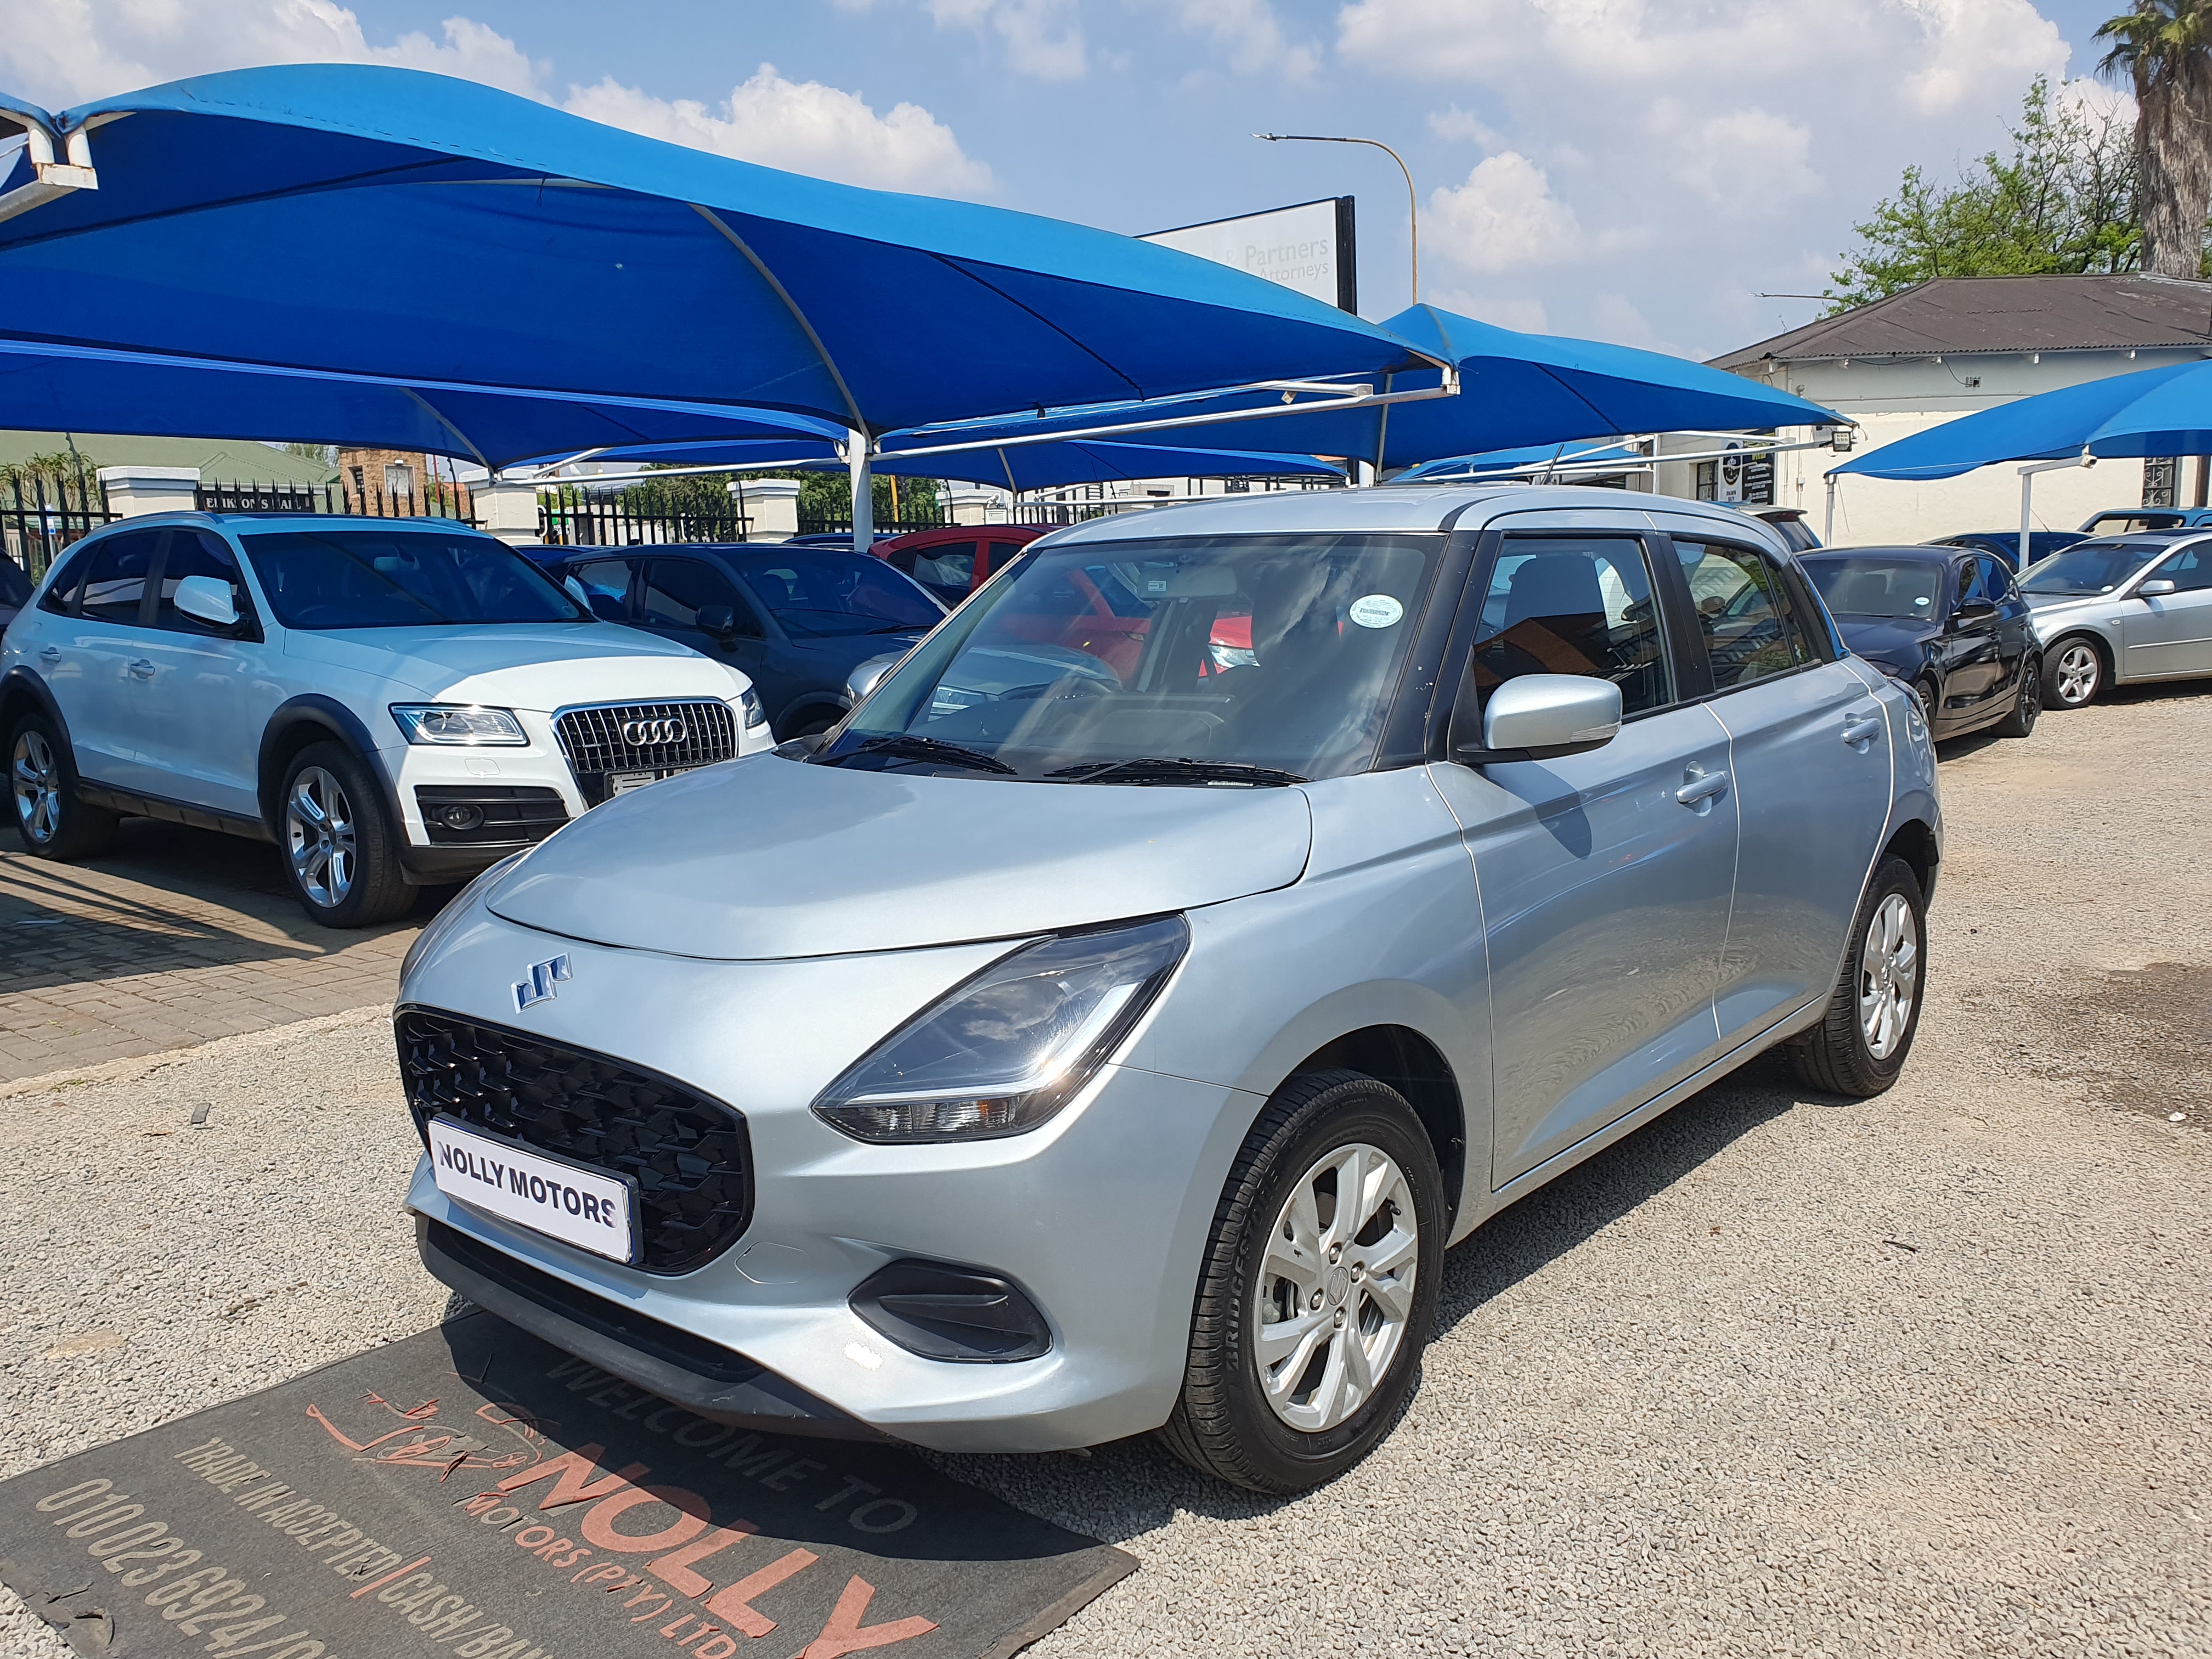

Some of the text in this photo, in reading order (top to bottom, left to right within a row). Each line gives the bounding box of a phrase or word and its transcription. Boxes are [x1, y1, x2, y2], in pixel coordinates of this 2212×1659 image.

[1245, 239, 1329, 268] Partners
[1260, 262, 1329, 281] Attorneys
[439, 1142, 618, 1228] NOLLY MOTORS
[173, 1436, 272, 1494] TRADE
[546, 1356, 918, 1534] WELCOME TO
[35, 1479, 145, 1538] 010
[234, 1481, 297, 1512] IN
[88, 1521, 203, 1587] 023
[257, 1498, 403, 1582] ACCEPTED
[496, 1443, 940, 1659] NOLLY
[452, 1492, 737, 1659] MOTORS (PTY) LTD
